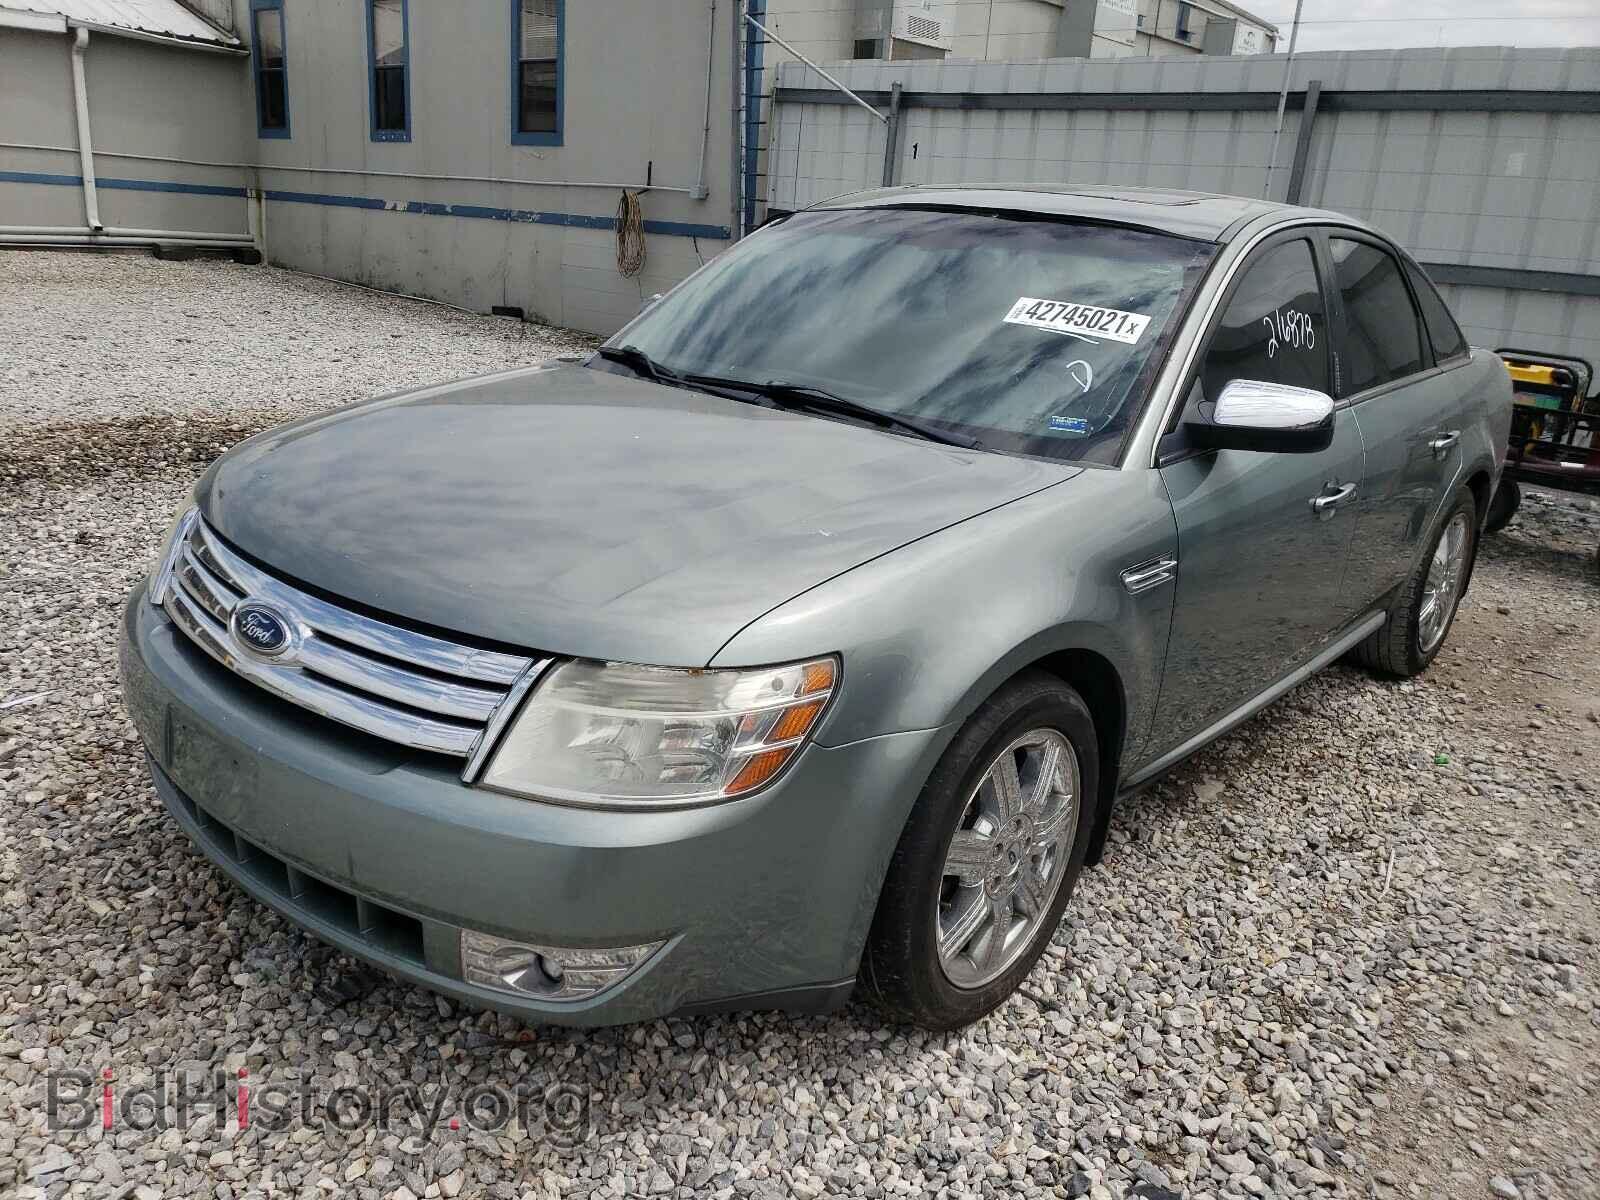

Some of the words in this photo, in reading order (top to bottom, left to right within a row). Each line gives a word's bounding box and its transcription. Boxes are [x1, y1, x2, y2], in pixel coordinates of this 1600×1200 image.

[1025, 300, 1130, 334] 42745021
[1263, 308, 1315, 358] 216878
[242, 612, 276, 643] Ford
